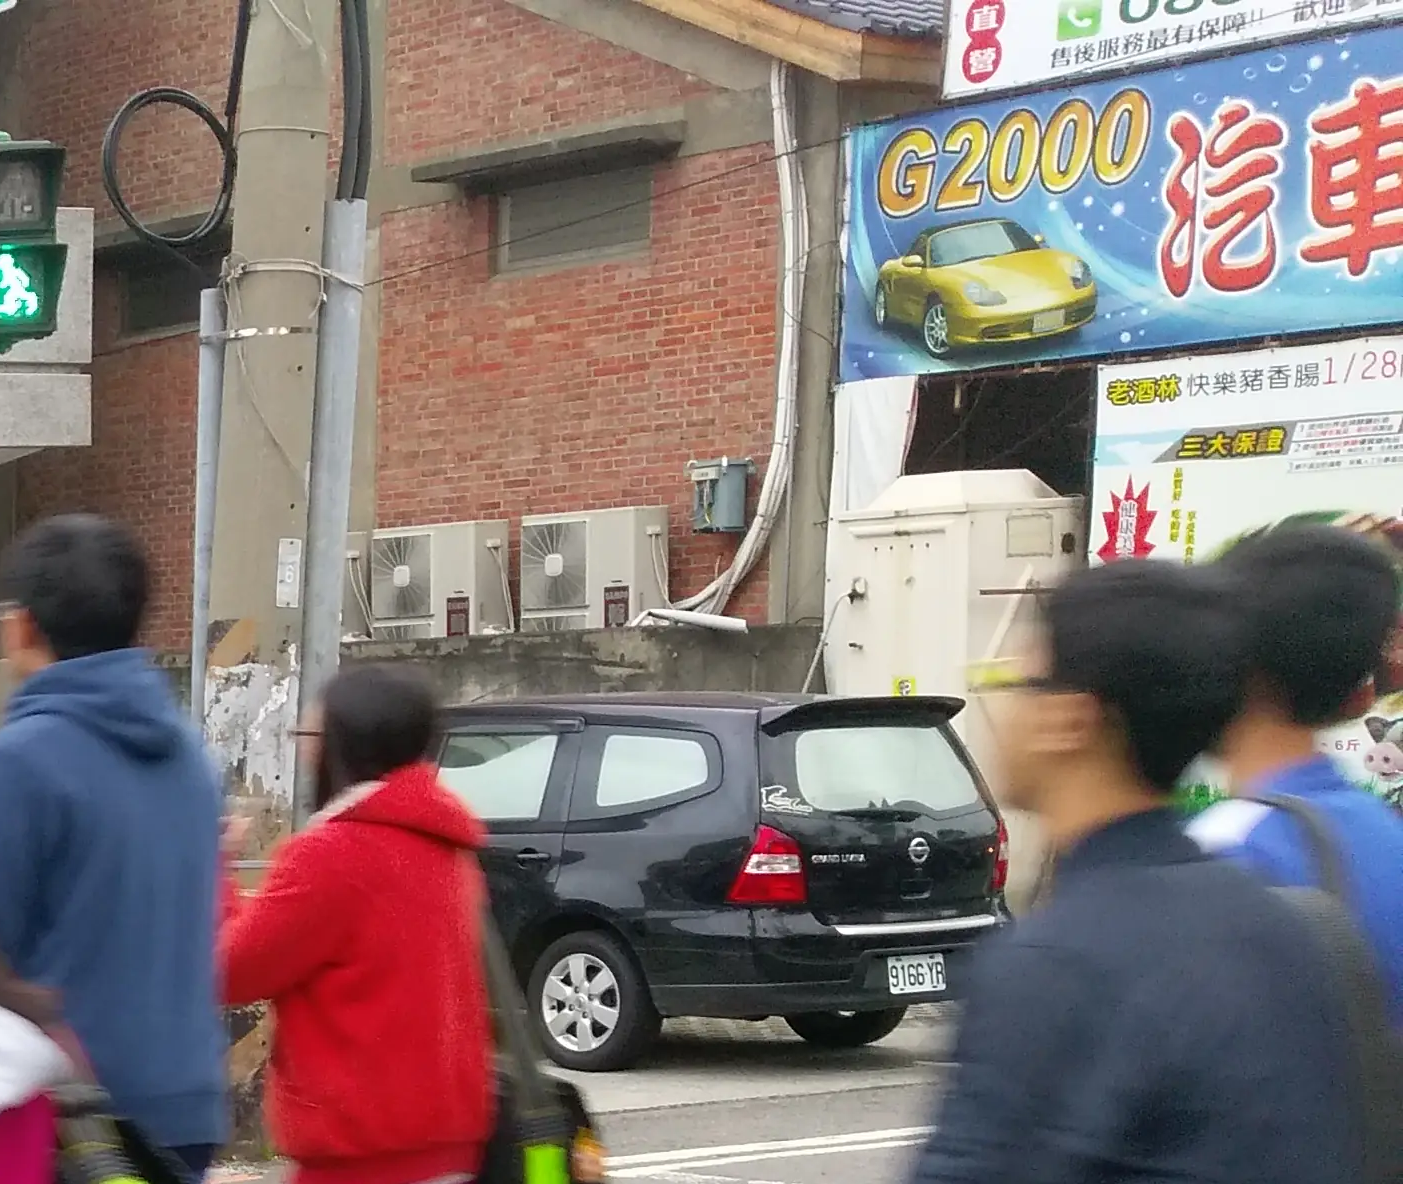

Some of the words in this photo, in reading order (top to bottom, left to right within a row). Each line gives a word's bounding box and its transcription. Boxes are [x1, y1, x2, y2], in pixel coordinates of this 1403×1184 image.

[969, 5, 999, 75] 直營
[877, 87, 1151, 219] G2000
[1158, 78, 1403, 299] 汽車
[1107, 374, 1181, 406] 老酒林
[1186, 363, 1320, 397] 快樂豬香腸
[1322, 349, 1403, 385] 1/28
[1176, 426, 1287, 460] 三大保證
[889, 961, 945, 988] 9166-YR
